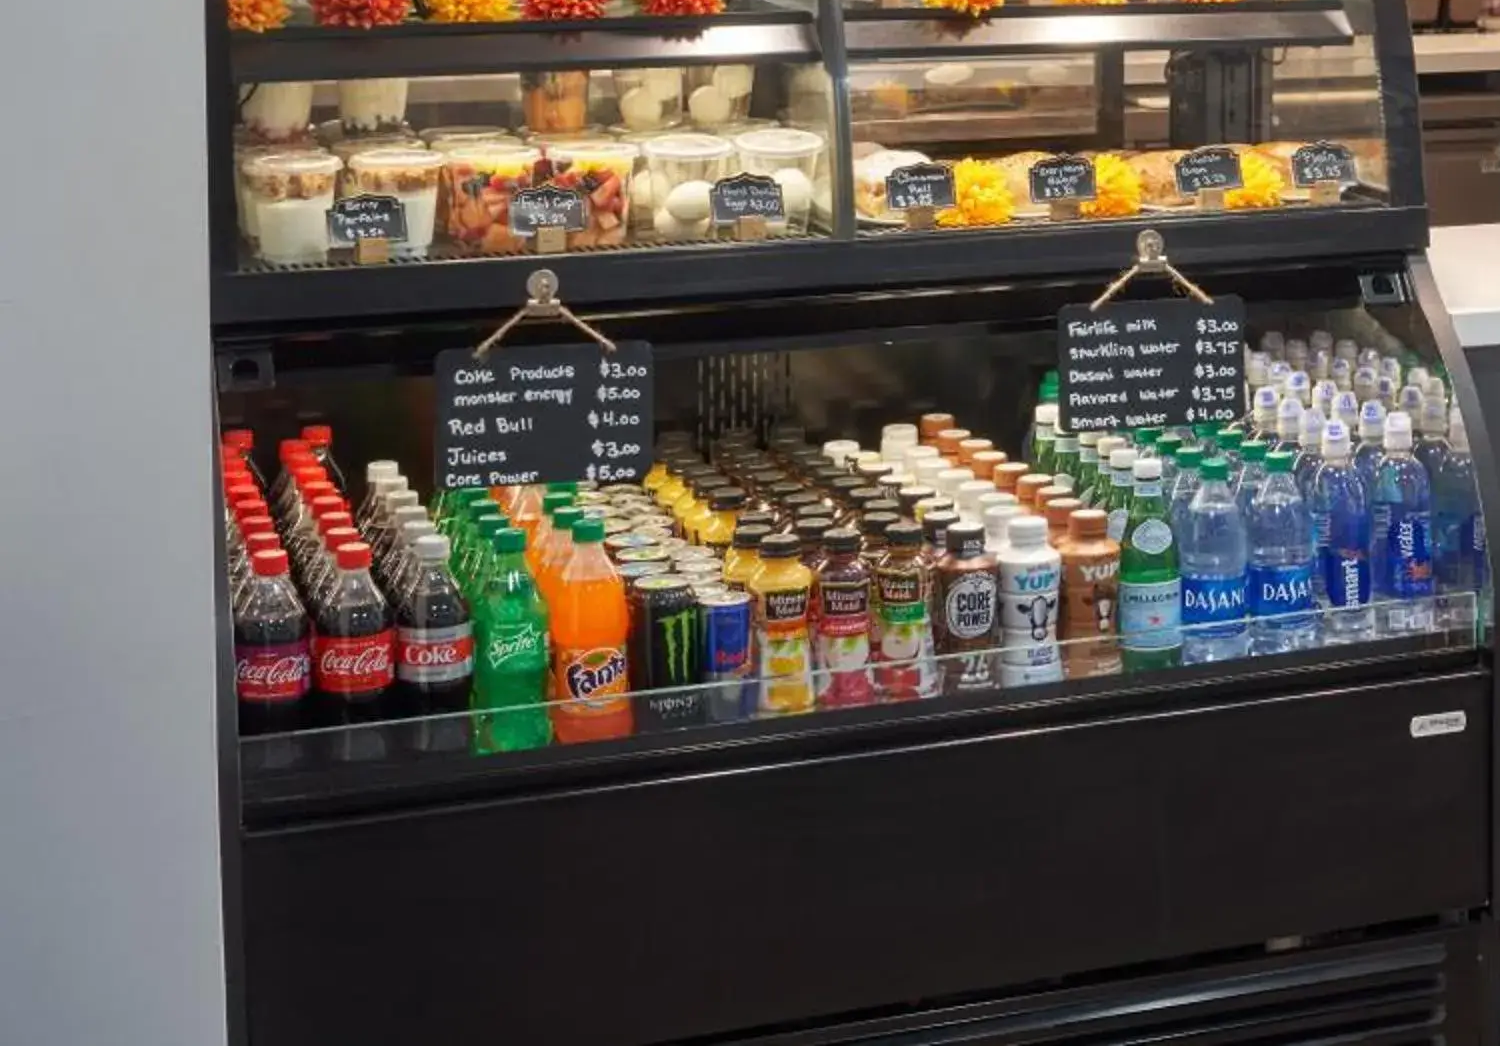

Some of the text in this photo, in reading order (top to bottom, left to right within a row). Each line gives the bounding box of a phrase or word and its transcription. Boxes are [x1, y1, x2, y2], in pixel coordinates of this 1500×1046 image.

[1197, 318, 1239, 334] $3.00
[1140, 343, 1180, 355] water
[1195, 341, 1239, 355] $3.75
[510, 365, 575, 381] Products
[600, 358, 647, 378] $3.00
[1069, 365, 1236, 384] Dasani water $3.00
[454, 385, 641, 407] monster energy $5.00
[1192, 386, 1235, 401] $3.75
[448, 418, 485, 437] Red
[496, 416, 534, 434] Bull
[1126, 412, 1168, 426] water
[447, 439, 641, 466] Juices $3.00
[446, 463, 636, 487] Core Power $5.00
[1399, 521, 1413, 558] water
[1342, 556, 1359, 609] smart
[957, 592, 992, 612] CORE
[957, 610, 991, 627] POWER
[405, 643, 458, 666] Coke
[489, 629, 542, 658] Sprite
[320, 644, 391, 675] Coca-Cola
